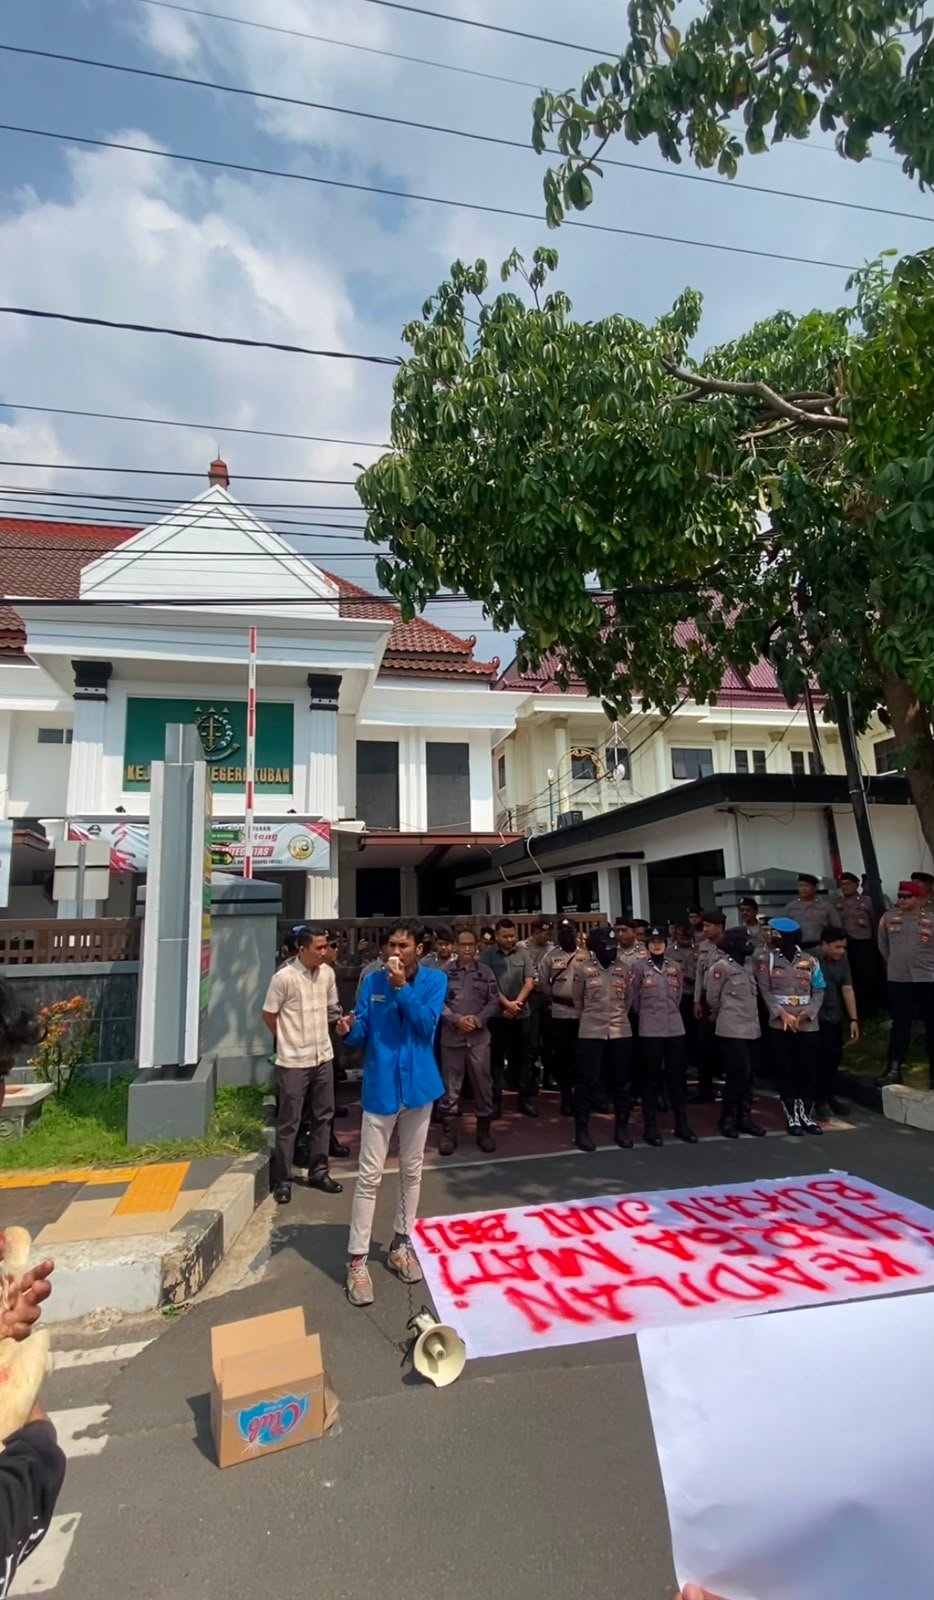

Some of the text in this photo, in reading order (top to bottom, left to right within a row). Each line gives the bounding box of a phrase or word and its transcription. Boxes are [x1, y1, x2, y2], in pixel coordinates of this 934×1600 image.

[524, 1199, 653, 1240] JUAL
[667, 1180, 877, 1225] BUKAN
[635, 1204, 932, 1264] HARGA
[505, 1245, 920, 1334] KEADILAN
